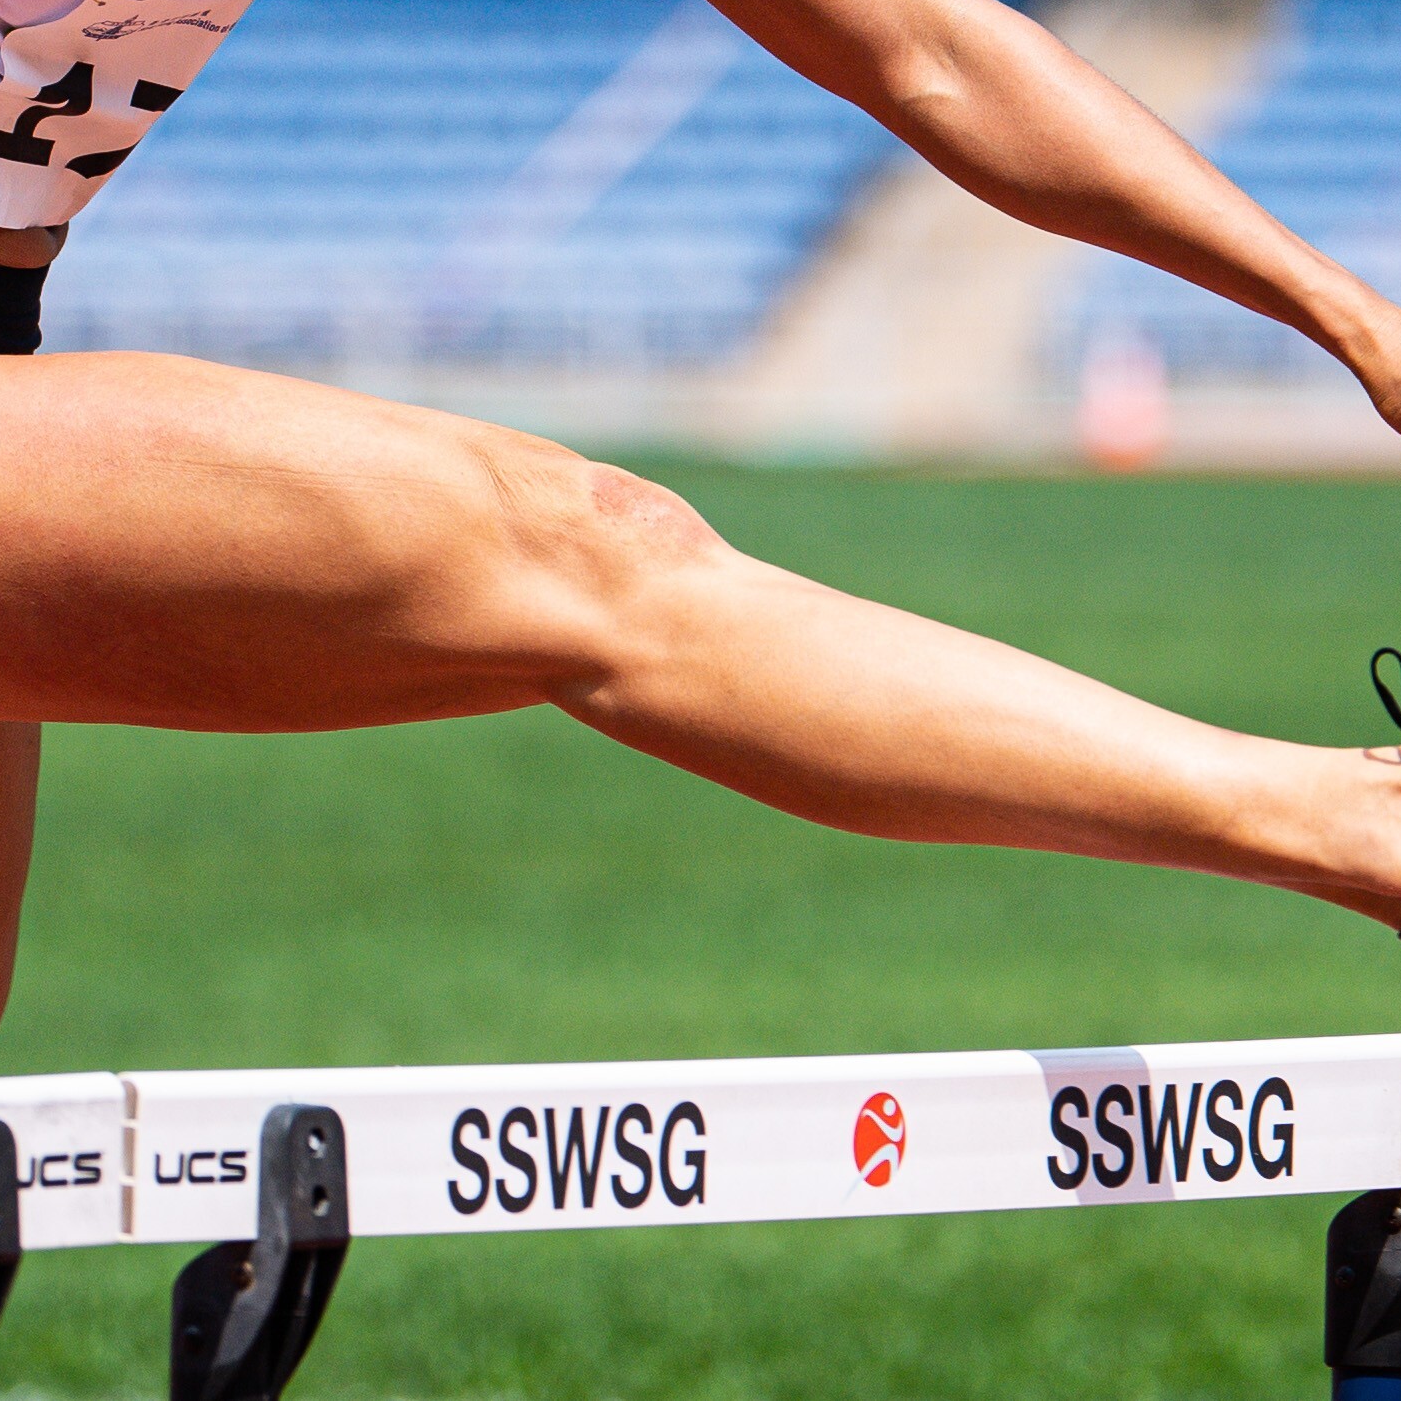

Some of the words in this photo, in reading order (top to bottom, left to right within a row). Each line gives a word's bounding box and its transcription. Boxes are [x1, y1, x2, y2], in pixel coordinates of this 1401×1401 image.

[154, 1150, 247, 1185] UCS
[448, 1101, 706, 1215] SSWSG
[1047, 1076, 1294, 1190] SSWSG
